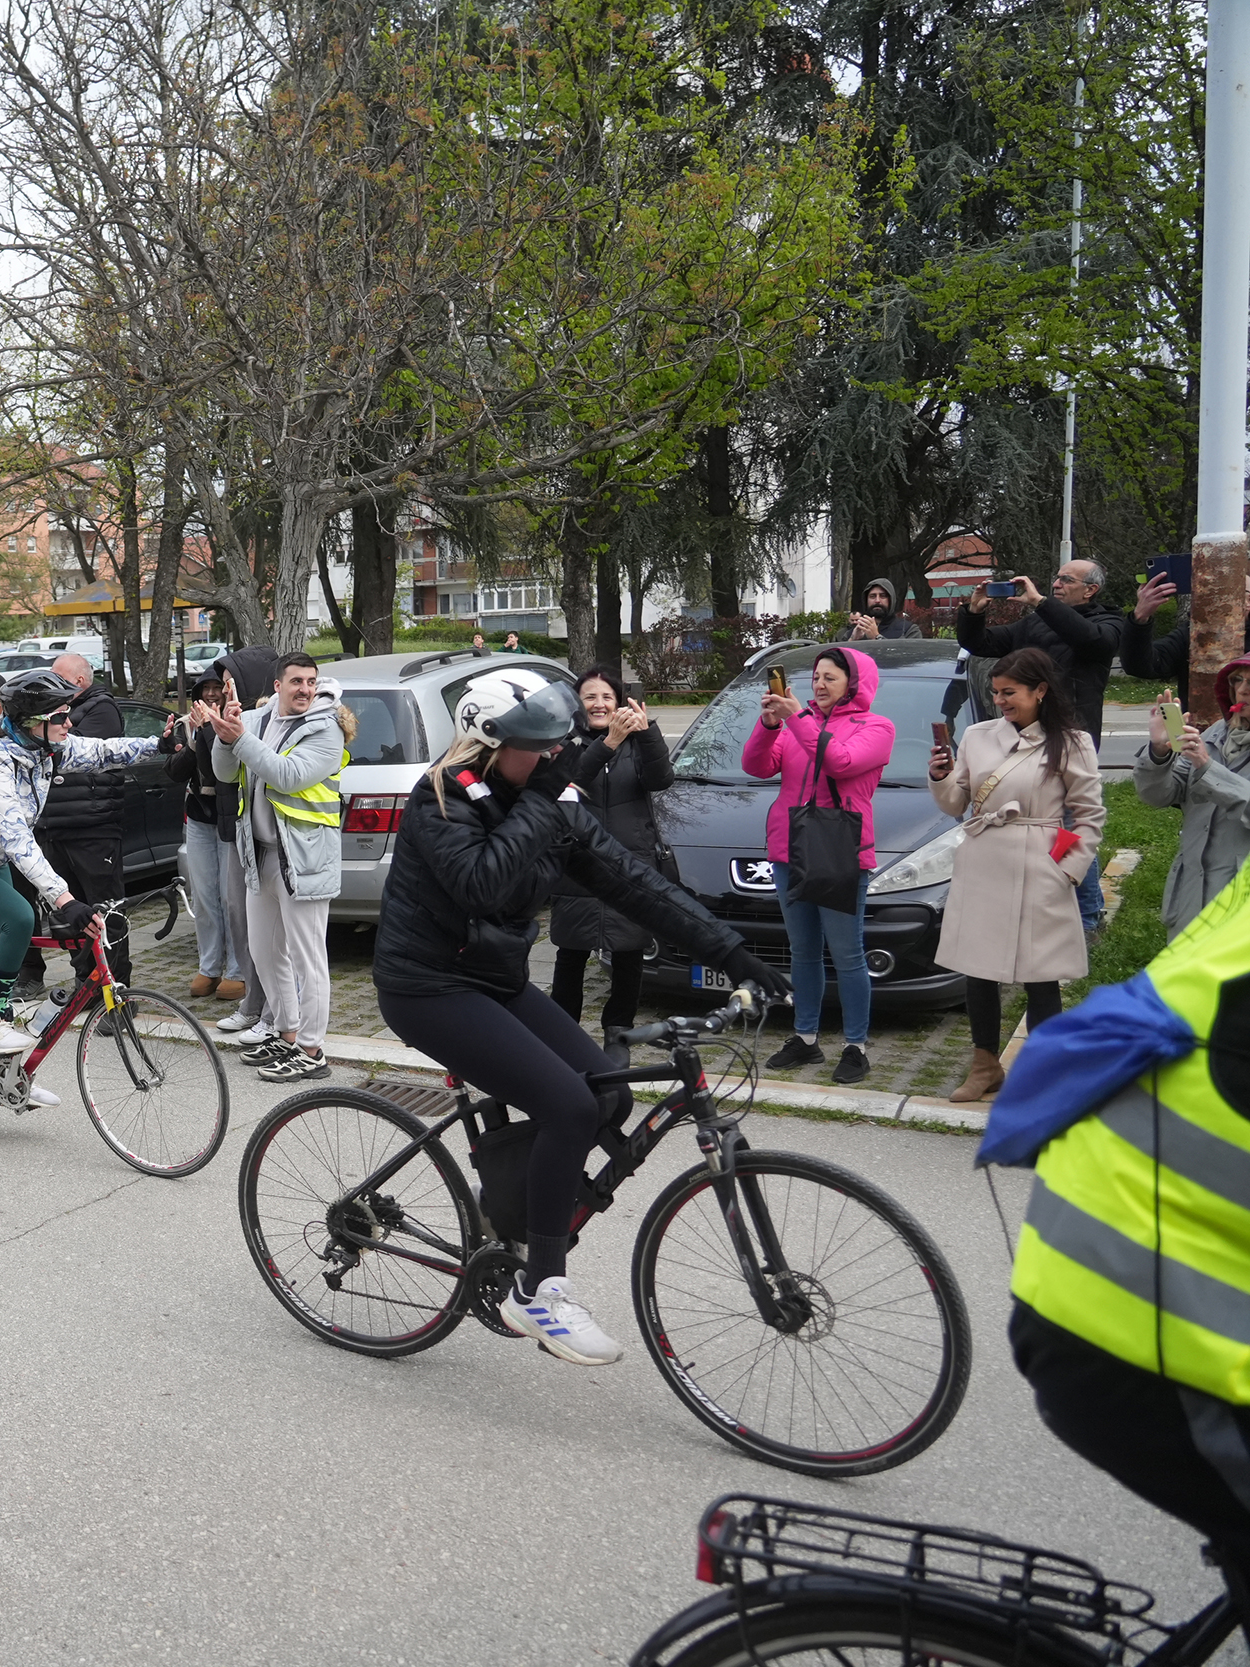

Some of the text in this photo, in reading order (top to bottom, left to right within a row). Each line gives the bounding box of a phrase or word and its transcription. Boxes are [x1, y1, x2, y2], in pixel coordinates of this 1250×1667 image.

[705, 969, 725, 987] BG
[275, 1277, 333, 1327] MERIDA
[667, 1357, 738, 1425] MERIDA
